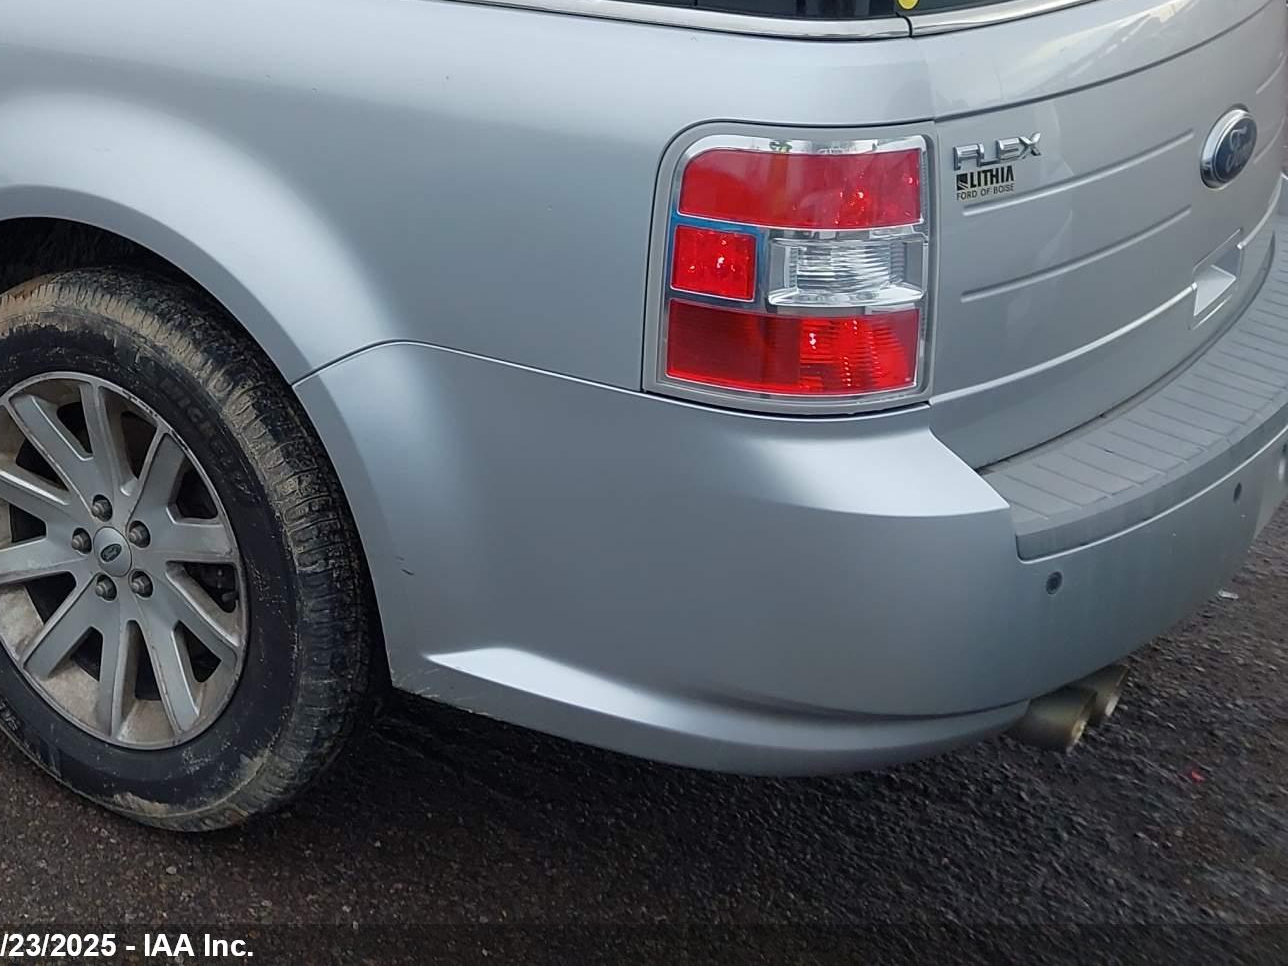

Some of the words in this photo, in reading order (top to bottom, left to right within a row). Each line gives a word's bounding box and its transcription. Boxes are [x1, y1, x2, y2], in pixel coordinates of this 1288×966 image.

[953, 133, 1041, 171] FLEX
[970, 165, 1014, 188] LITHIA
[957, 190, 977, 201] FORD
[981, 188, 990, 196] OF
[994, 183, 1014, 194] BOISE
